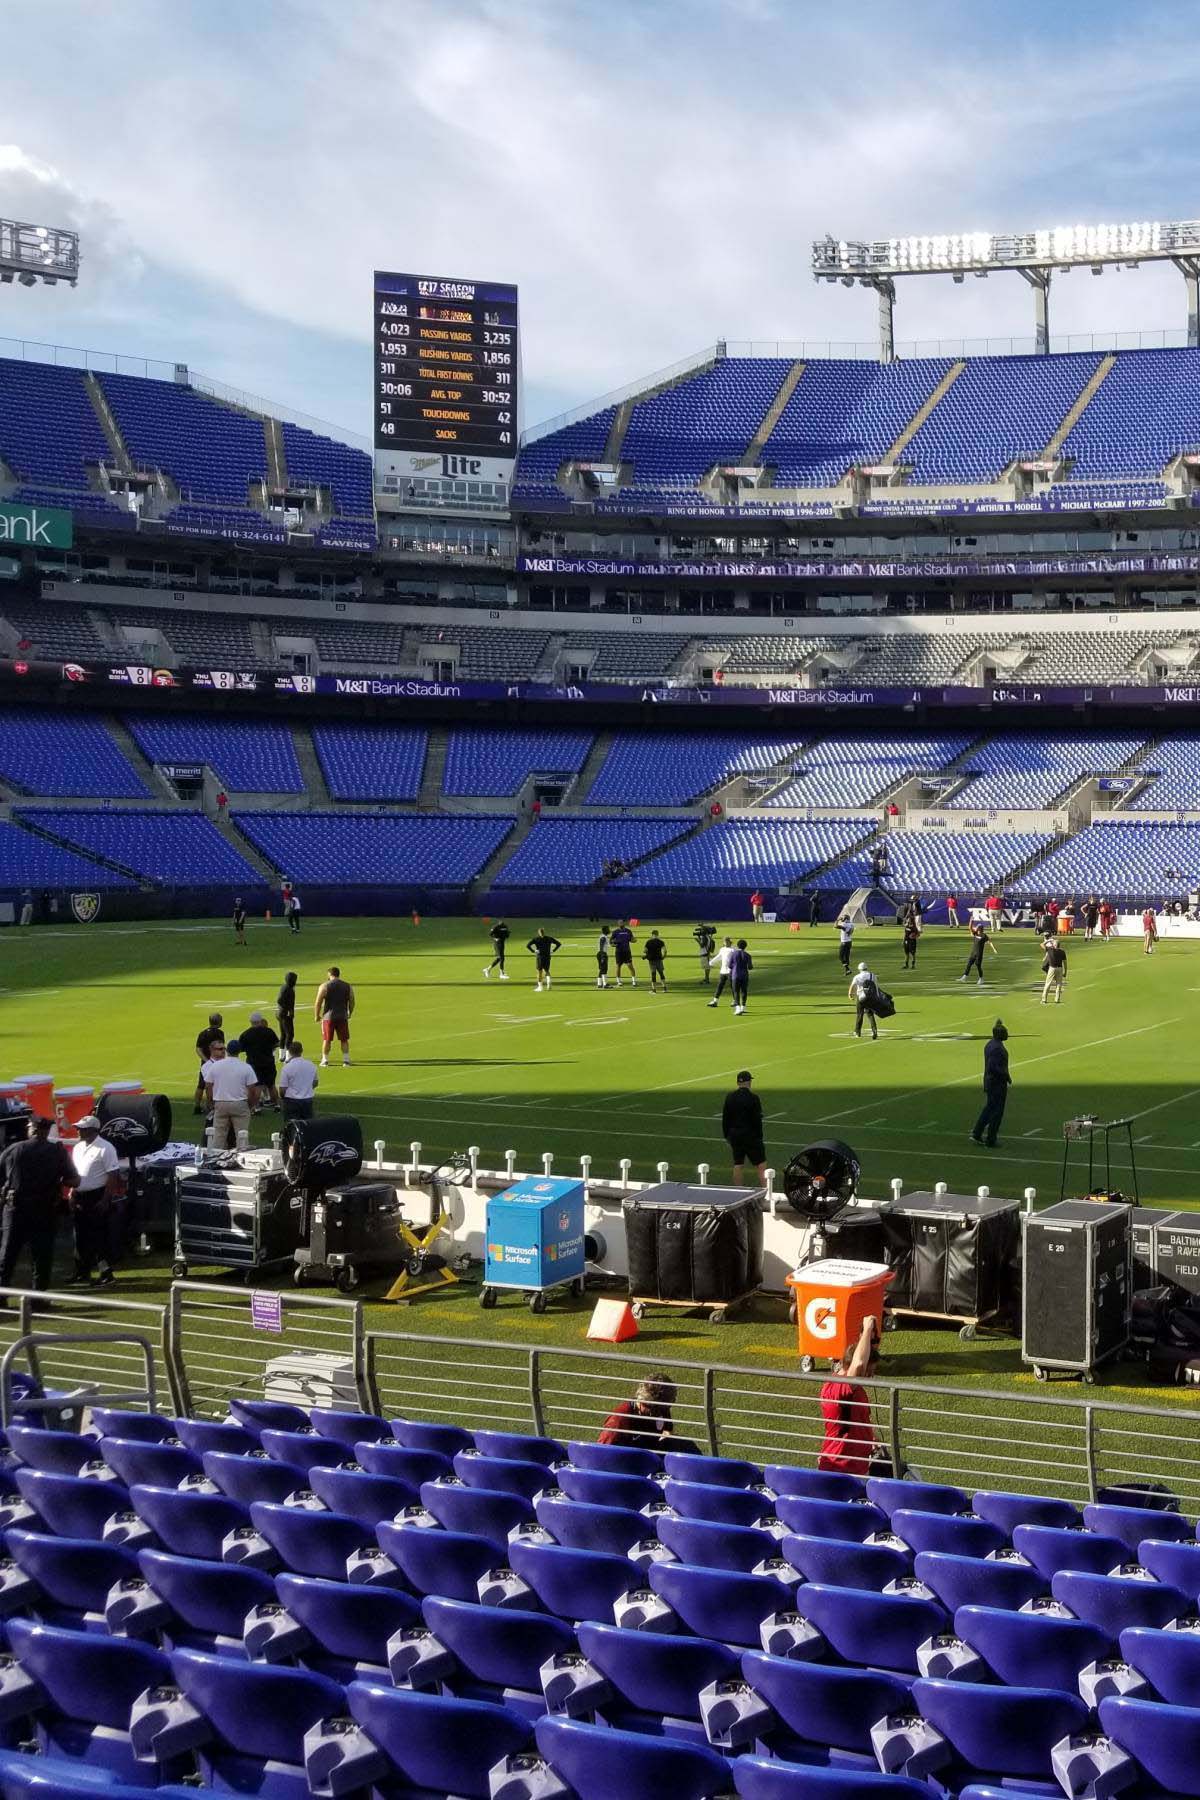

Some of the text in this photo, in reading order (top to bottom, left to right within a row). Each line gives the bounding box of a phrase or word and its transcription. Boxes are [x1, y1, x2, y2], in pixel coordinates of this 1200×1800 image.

[380, 321, 410, 336] 4,023
[420, 329, 472, 342] PASSING YARDS
[483, 332, 511, 345] 3,235
[380, 342, 407, 356] 1,953
[419, 349, 473, 362] RUSHING YARDS
[483, 351, 511, 365] 1,856
[380, 362, 395, 374] 311
[419, 368, 474, 382] TOTAL FIRST DOWNS
[496, 372, 511, 385] 311
[380, 382, 412, 396] 30:06
[447, 390, 462, 401] TOP
[482, 390, 511, 404] 30:52
[380, 402, 391, 414] 51
[422, 408, 470, 421] TOUCHDOWNS
[498, 412, 511, 424] 42
[380, 422, 395, 435] 48
[435, 429, 457, 440] SACKS
[500, 432, 511, 444] 41
[440, 454, 482, 479] Lite
[667, 507, 686, 515] RING
[687, 507, 698, 515] OF
[699, 507, 725, 516] HONOR
[976, 503, 1004, 512] ARTHUR
[1014, 502, 1042, 512] MODELL
[1061, 502, 1092, 511] MICHAEL
[1128, 499, 1166, 508] 1997-2002
[739, 507, 833, 517] EARNEST BYNER 1996-2003
[221, 529, 285, 542] 410-324-6141
[322, 538, 371, 549] RAVENS
[525, 558, 555, 572] M&T
[556, 560, 586, 574] Bank
[586, 560, 635, 575] Stadium
[868, 564, 896, 576] M&T
[897, 564, 923, 576] Bank
[924, 563, 968, 576] Stadium
[336, 679, 461, 698] M&T Bank Stadium
[1164, 687, 1196, 701] M&T
[768, 690, 874, 703] M&T Bank Stadium
[505, 1245, 538, 1257] Microsoft
[1055, 1244, 1064, 1252] 29
[505, 1255, 531, 1265] Surface
[1175, 1264, 1199, 1277] FIELD
[805, 1297, 836, 1340] G
